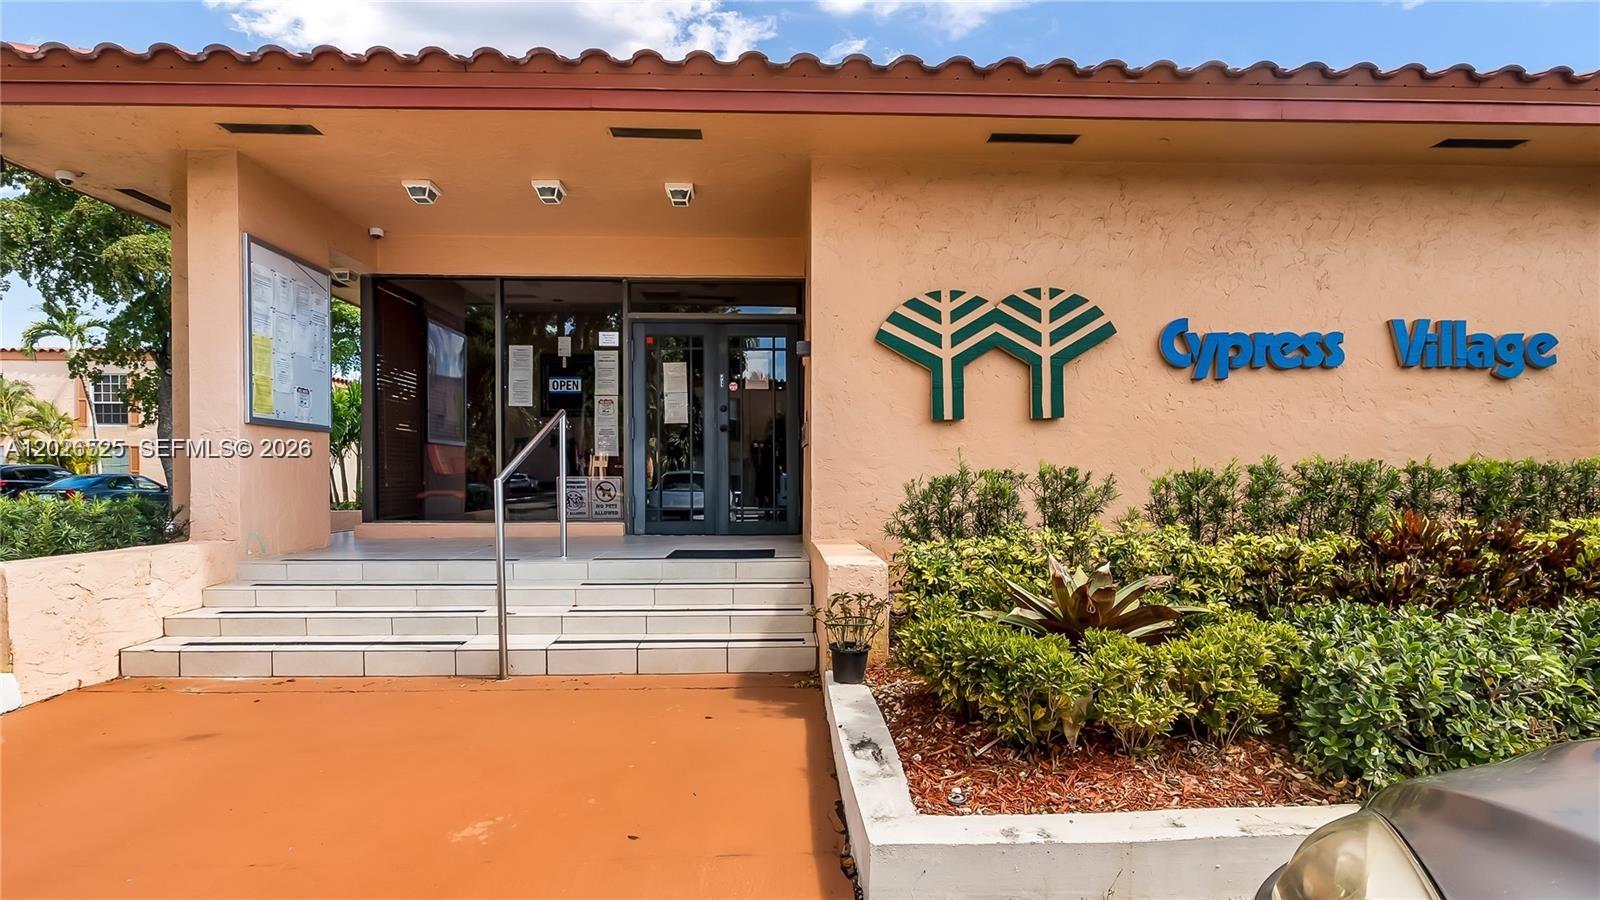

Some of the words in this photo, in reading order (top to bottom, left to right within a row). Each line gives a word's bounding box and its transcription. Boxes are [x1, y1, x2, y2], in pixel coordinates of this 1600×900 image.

[1157, 317, 1346, 381] Cypress
[1386, 318, 1559, 380] Village
[552, 380, 579, 391] OPEN
